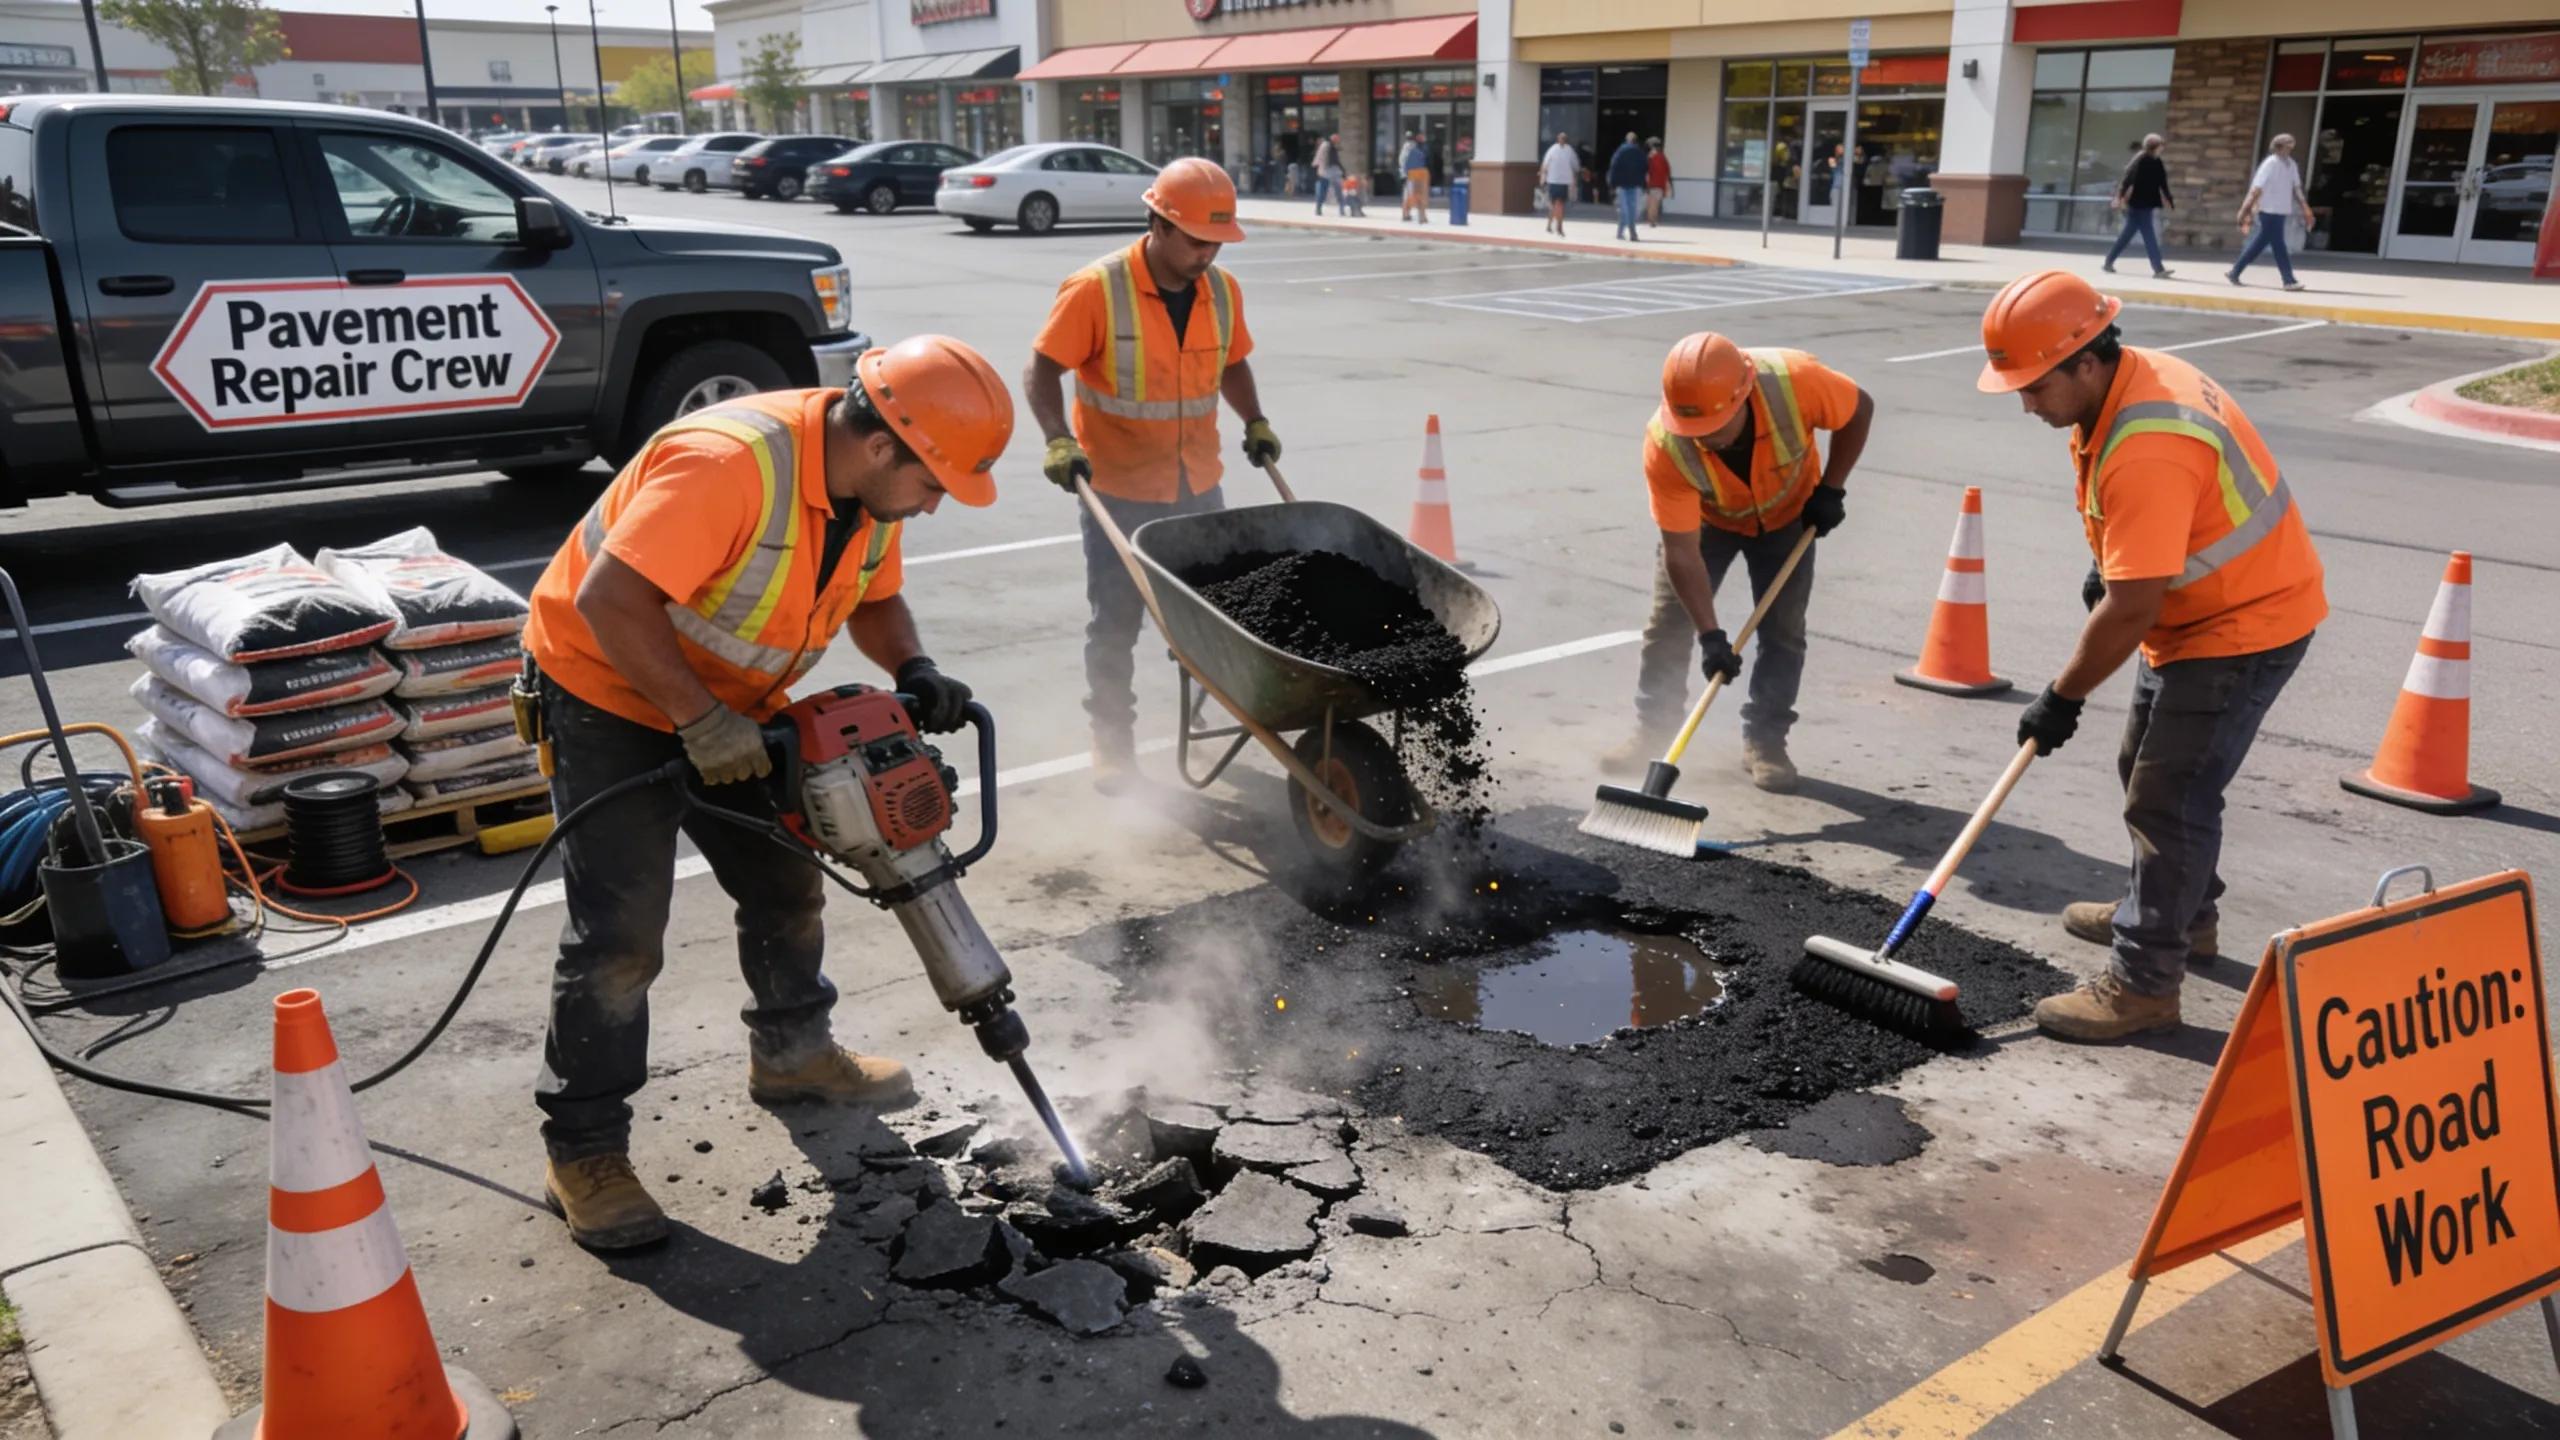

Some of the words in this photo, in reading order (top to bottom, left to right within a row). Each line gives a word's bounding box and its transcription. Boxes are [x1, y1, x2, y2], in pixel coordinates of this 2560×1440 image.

[226, 293, 501, 351] Pavement
[211, 351, 377, 414] Repair
[391, 348, 512, 394] Crew
[2317, 967, 2525, 1080] Caution:
[2363, 1058, 2501, 1180] Road
[2375, 1166, 2516, 1287] Work
